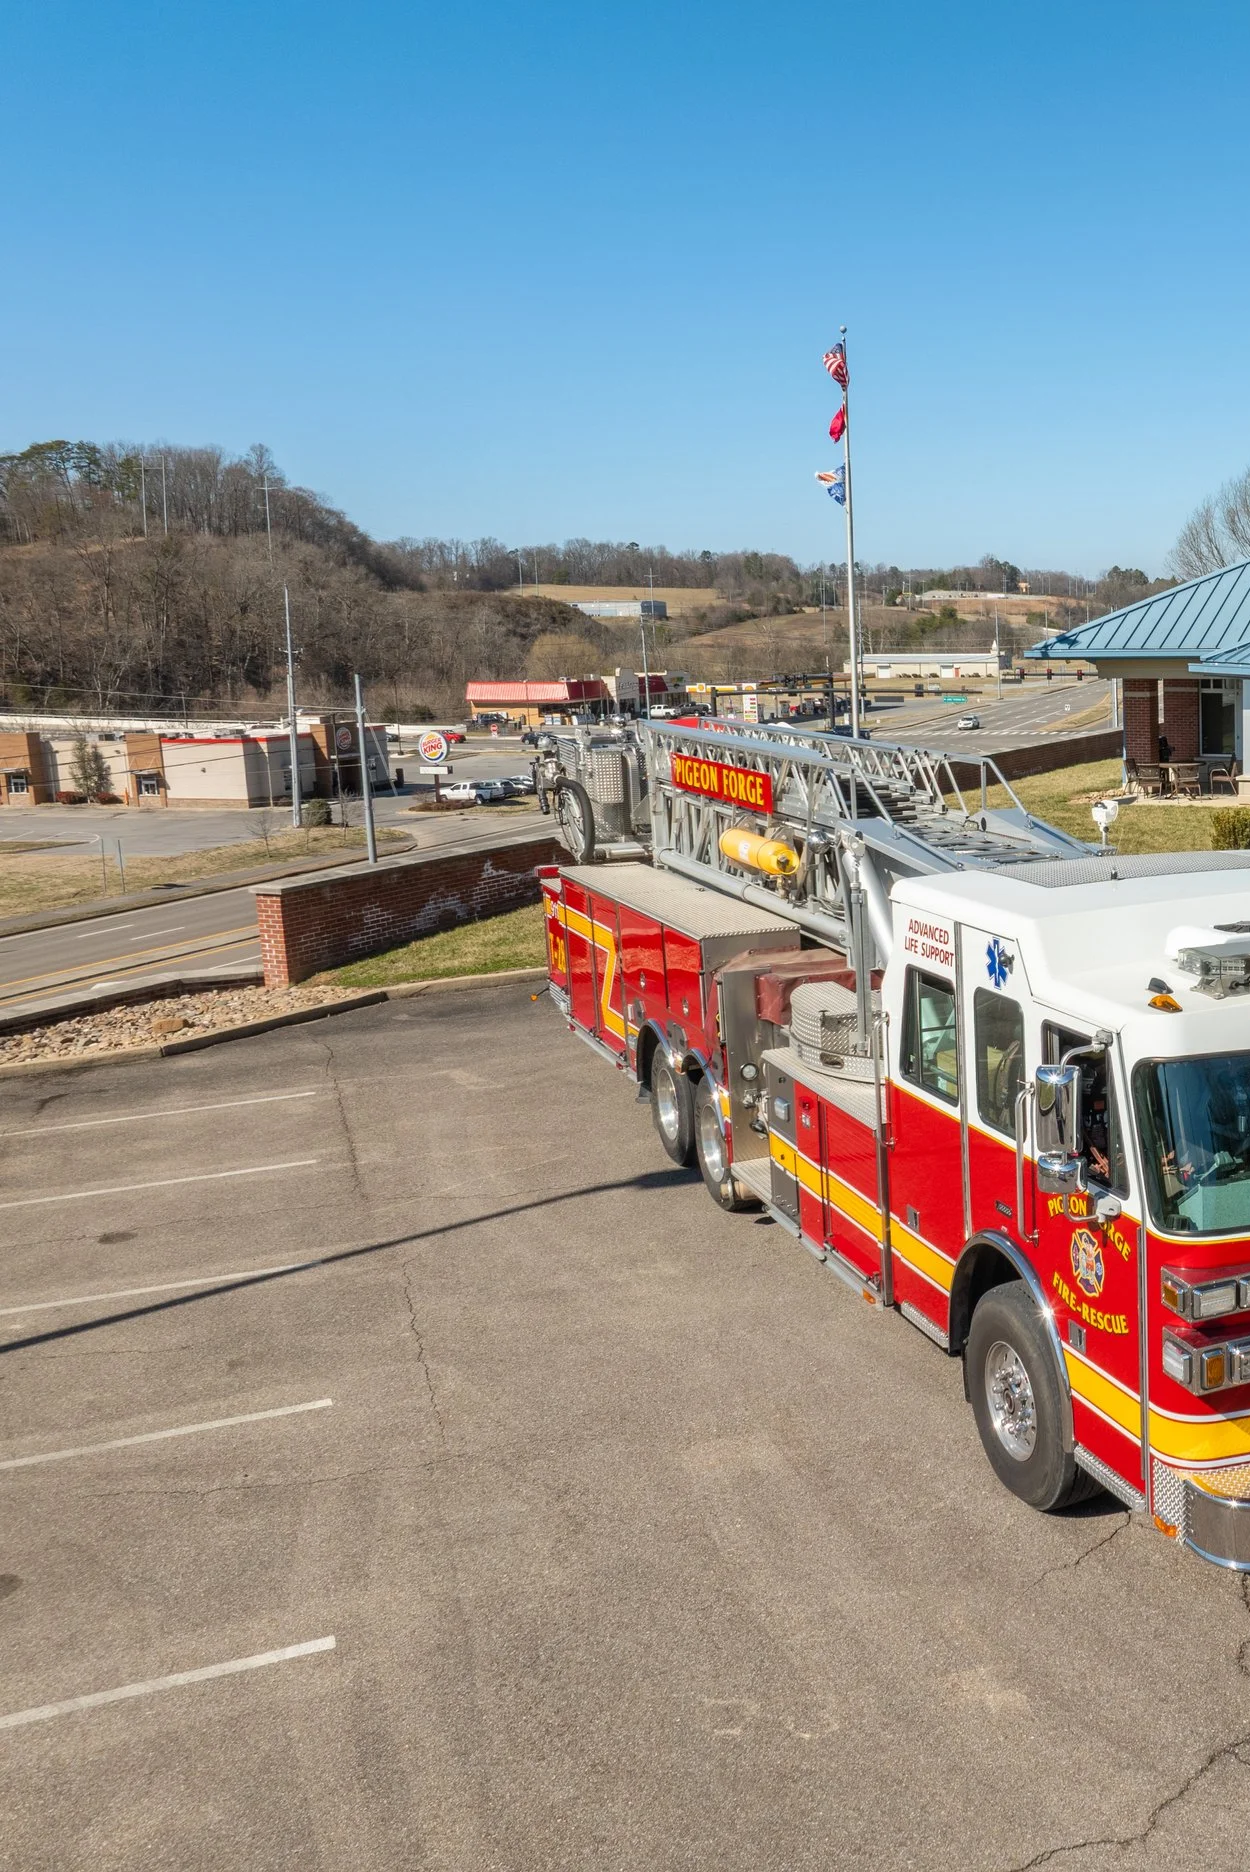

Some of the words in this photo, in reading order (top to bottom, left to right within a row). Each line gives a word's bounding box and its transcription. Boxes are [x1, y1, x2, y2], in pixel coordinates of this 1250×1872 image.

[424, 743, 442, 754] KING
[675, 758, 719, 793] PIGEON
[722, 769, 765, 806] FORGE
[904, 936, 918, 954] LIFE
[921, 942, 954, 967] SUPPORT
[908, 919, 949, 945] ADVANCED
[1048, 1195, 1087, 1217] PIGON
[1104, 1219, 1131, 1262] RGE
[1052, 1271, 1129, 1334] FIRE-RESCUE
